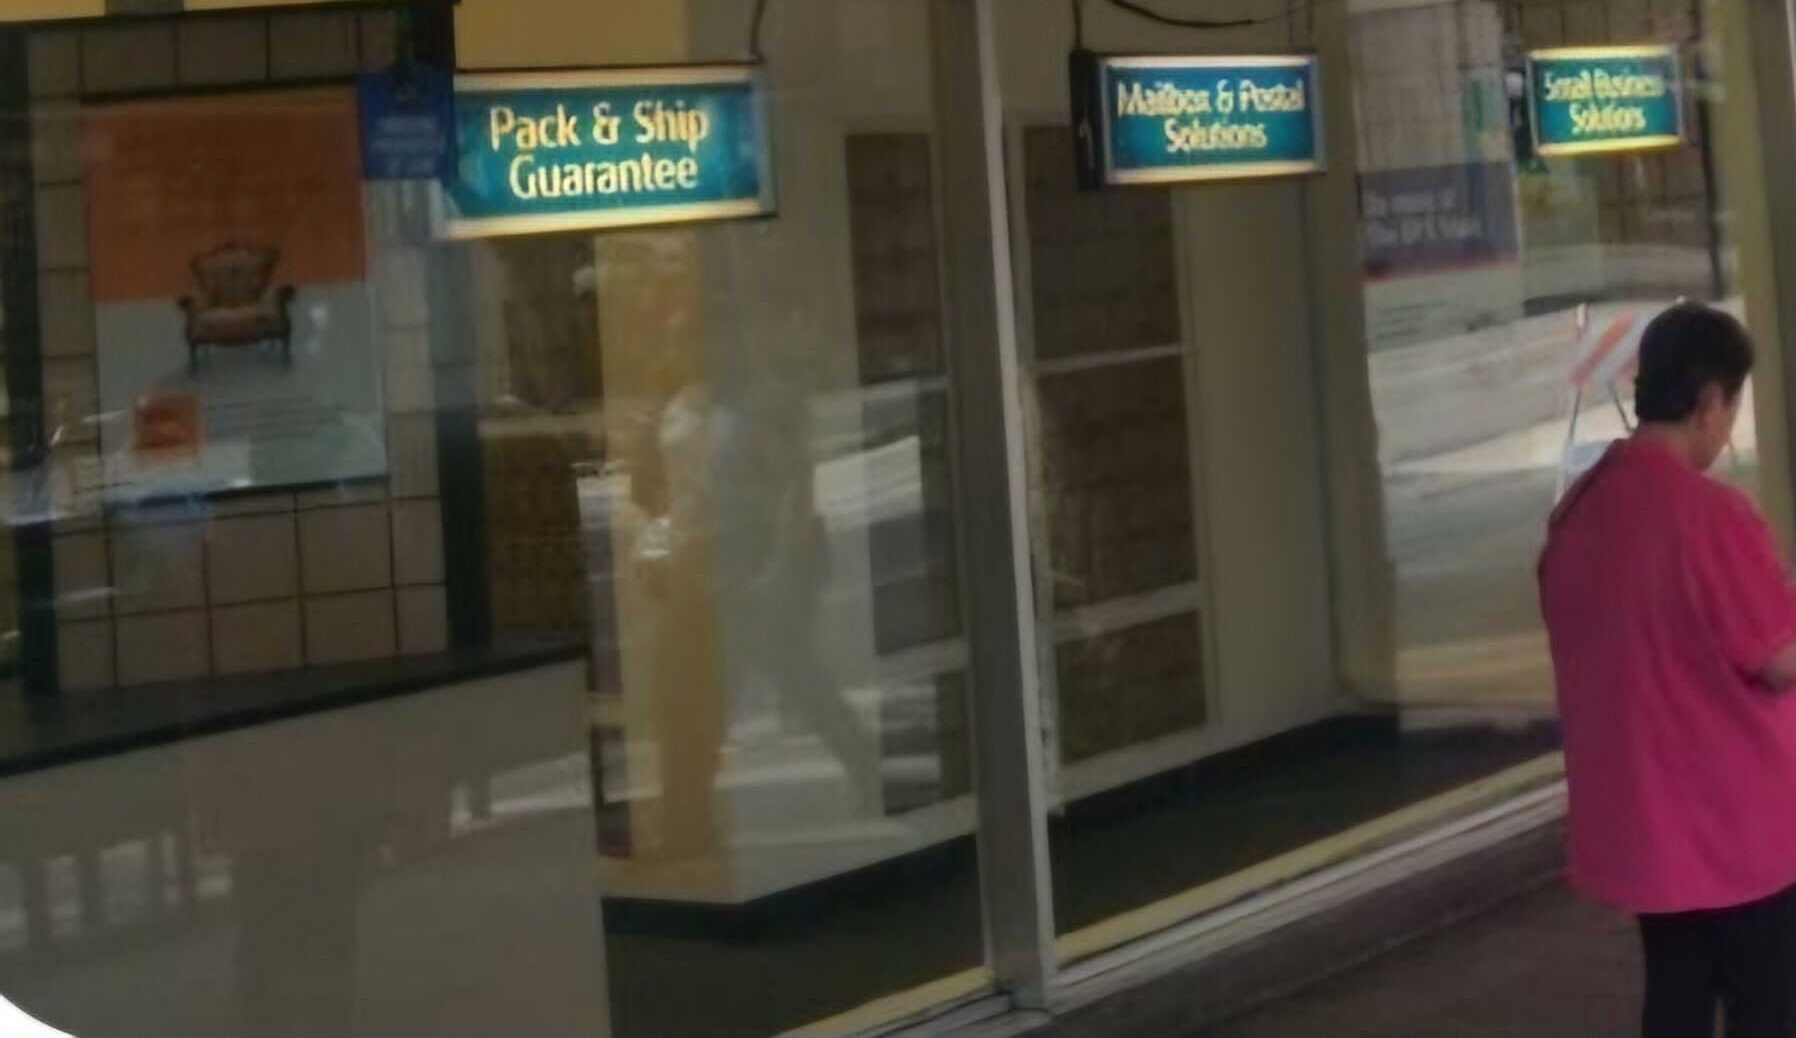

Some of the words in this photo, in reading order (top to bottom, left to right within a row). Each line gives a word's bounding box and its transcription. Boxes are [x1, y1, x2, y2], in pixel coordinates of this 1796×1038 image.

[1117, 81, 1211, 117] Mailbox
[1217, 79, 1234, 112] &
[1240, 78, 1304, 111] Postal
[489, 104, 581, 151] Pack
[593, 102, 620, 145] &
[634, 99, 708, 152] Ship
[1164, 117, 1267, 153] Solutions
[1569, 101, 1646, 135] Solutions
[510, 153, 699, 200] Guarantee
